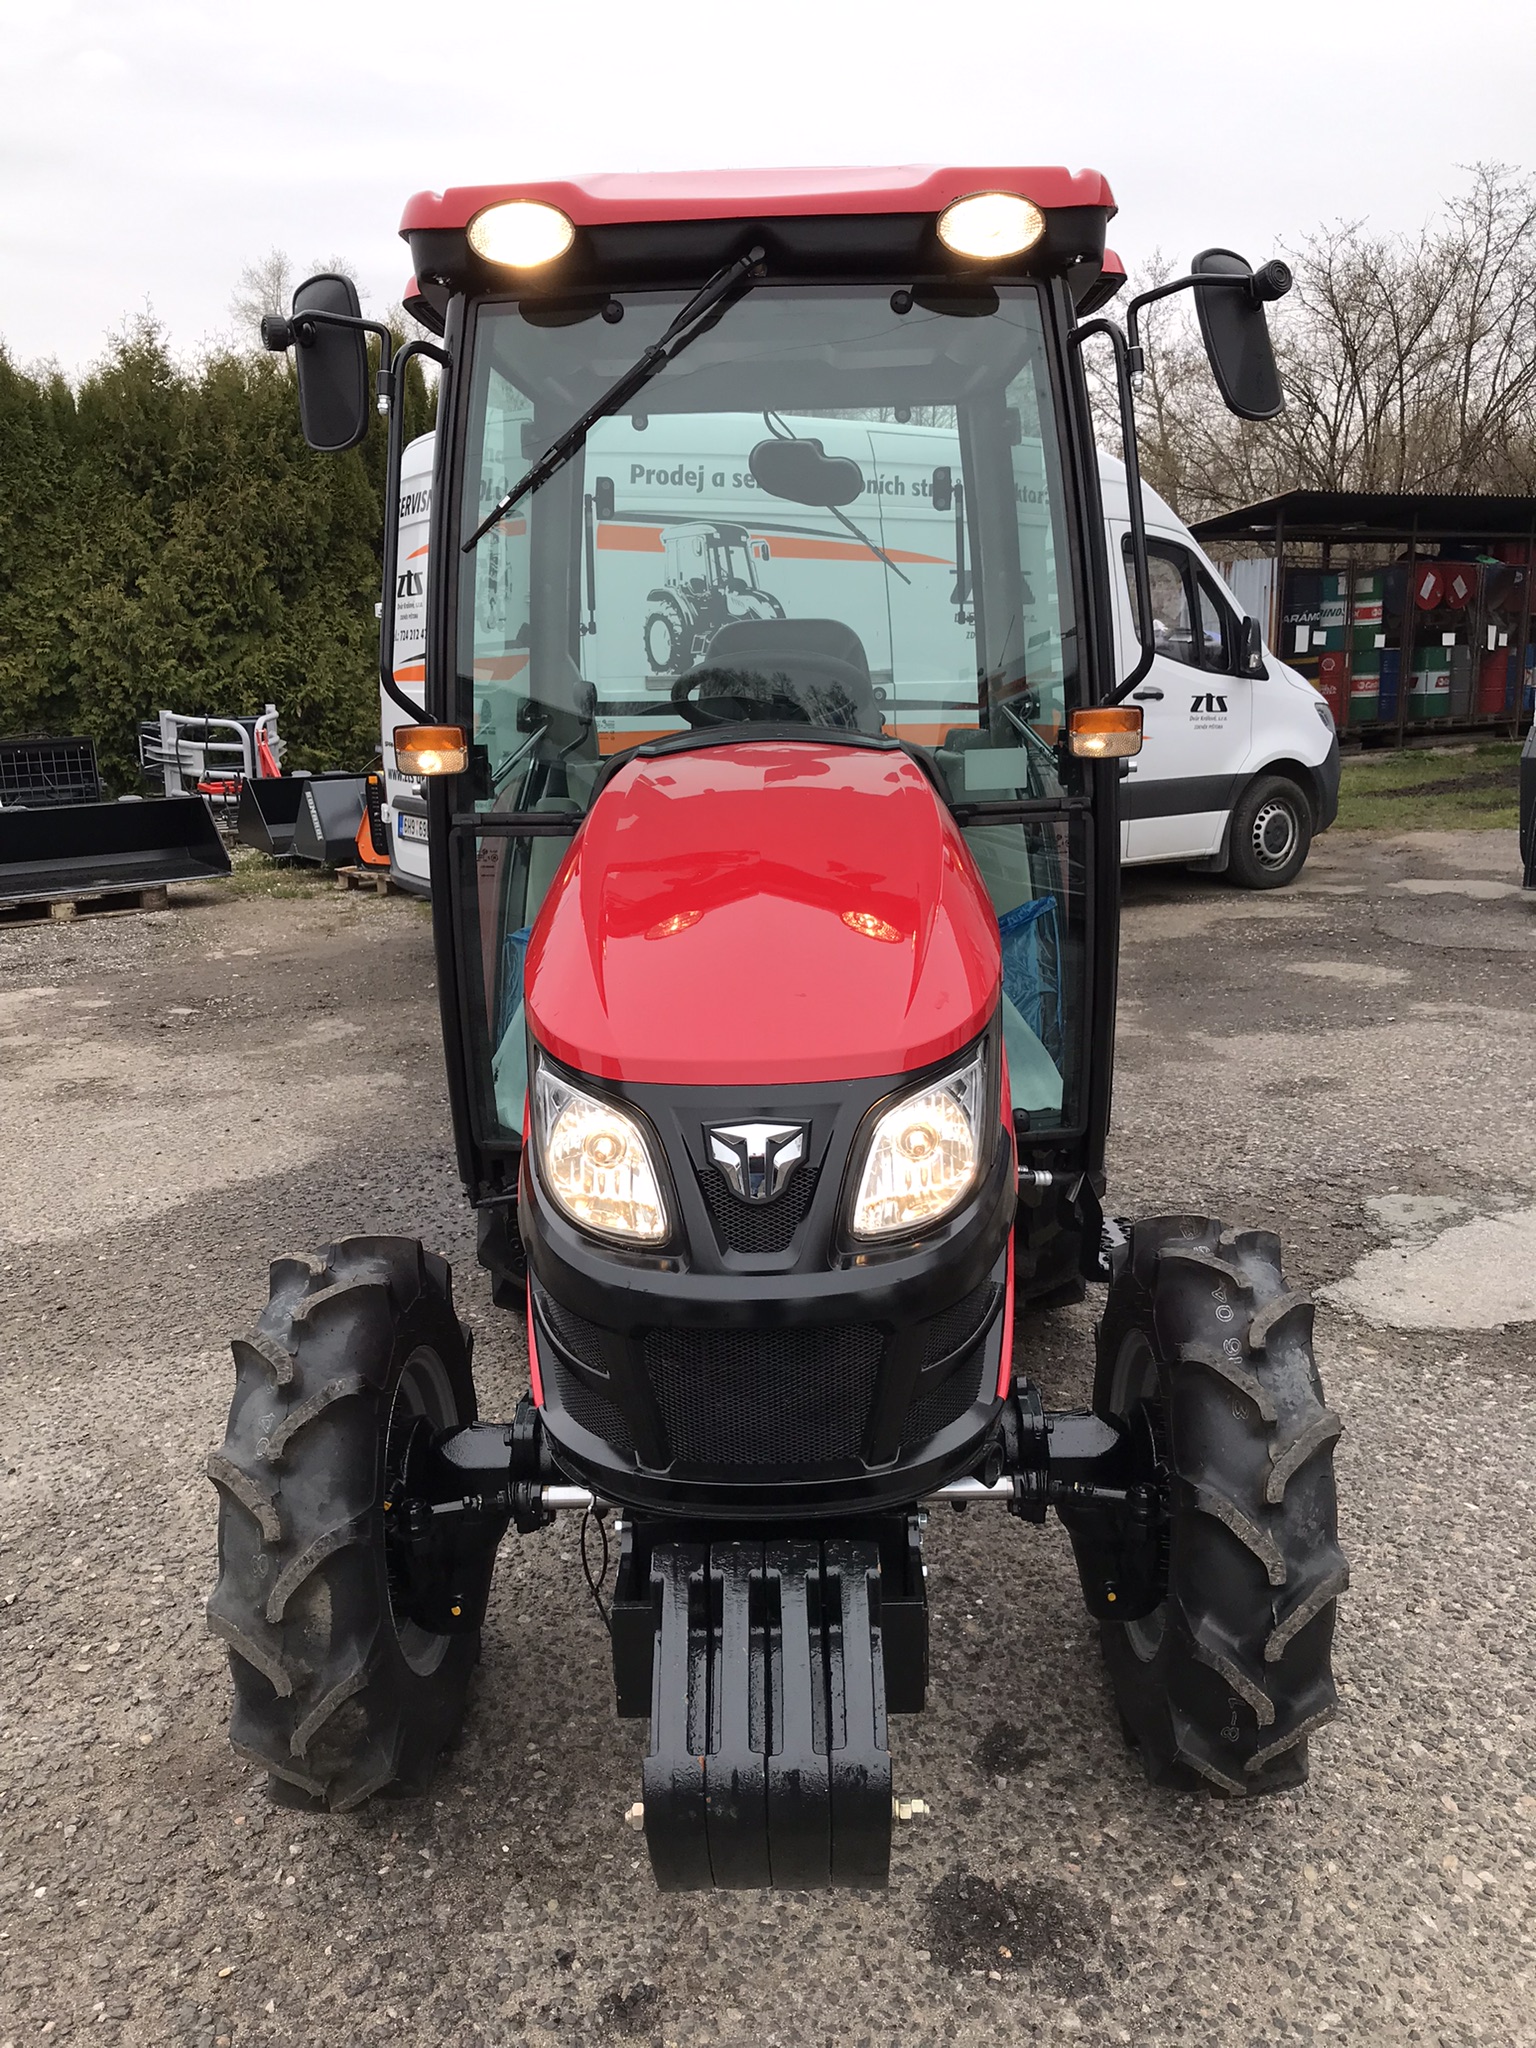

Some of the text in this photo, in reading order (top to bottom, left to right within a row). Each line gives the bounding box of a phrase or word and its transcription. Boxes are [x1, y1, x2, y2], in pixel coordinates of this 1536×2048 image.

[630, 464, 704, 493] Prodej
[711, 472, 725, 487] a
[732, 472, 762, 489] se
[867, 474, 905, 496] ních
[397, 570, 423, 598] zts
[1190, 693, 1228, 712] zts
